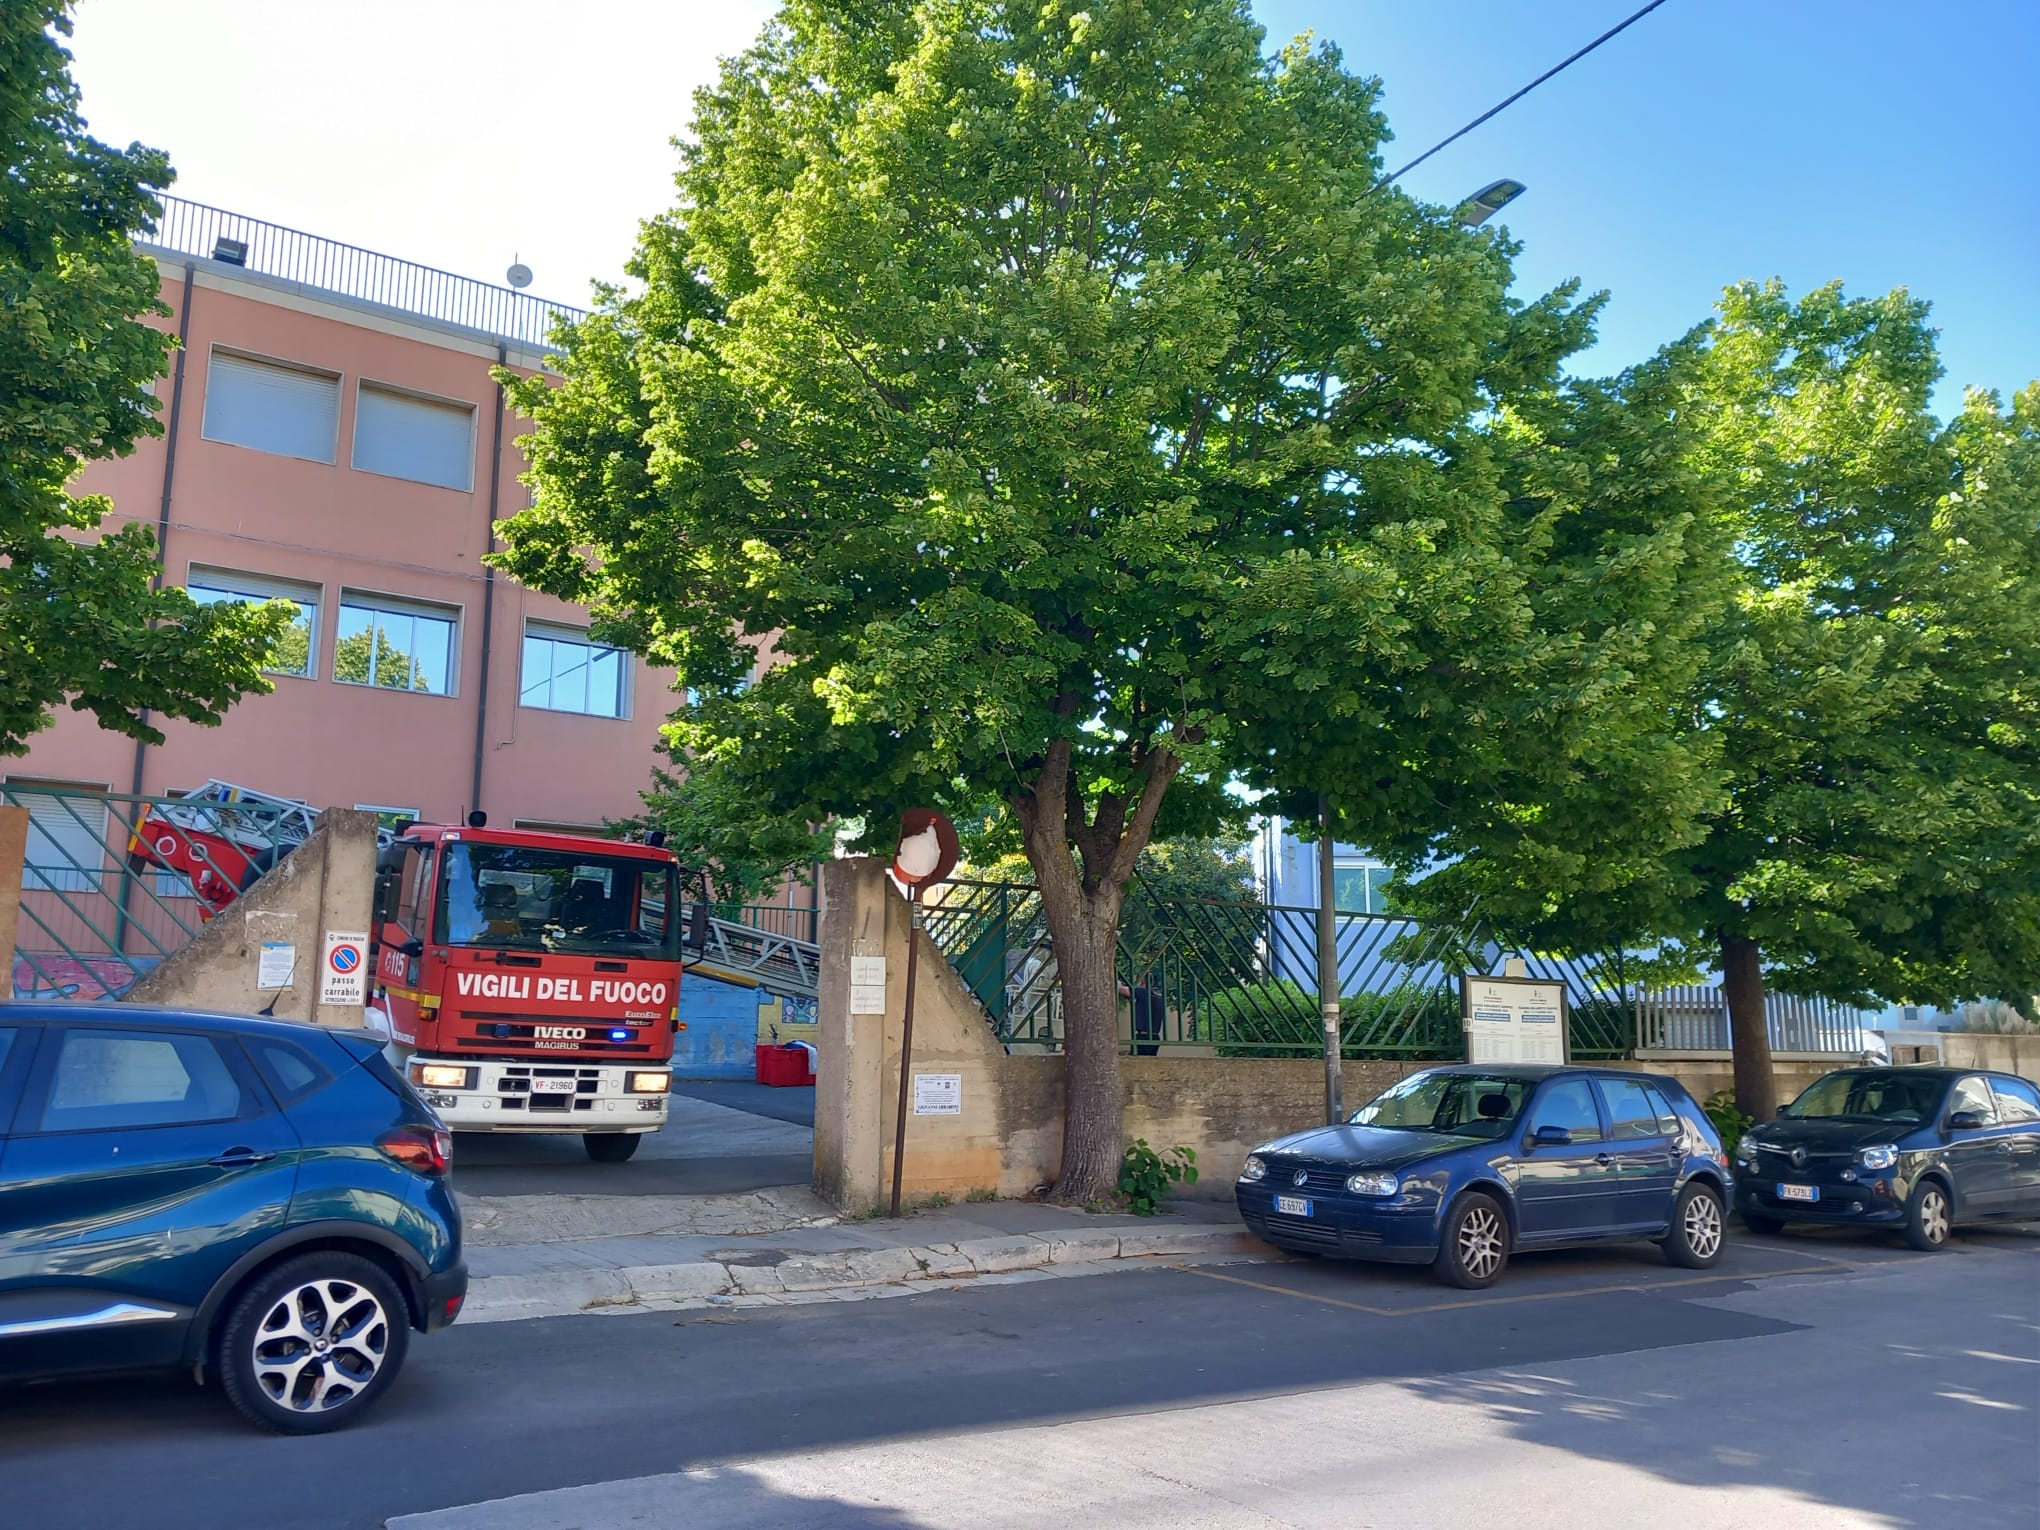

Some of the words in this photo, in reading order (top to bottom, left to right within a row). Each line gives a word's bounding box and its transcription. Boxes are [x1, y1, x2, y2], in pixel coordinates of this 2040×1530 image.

[390, 951, 406, 977] 115
[331, 977, 355, 986] passo
[324, 987, 360, 997] carrabile
[457, 972, 530, 999] VIGILI
[536, 977, 583, 1002] DEL
[589, 980, 667, 1005] FUOCO
[533, 1026, 587, 1040] IVECO
[534, 1041, 580, 1050] MAGIRUS
